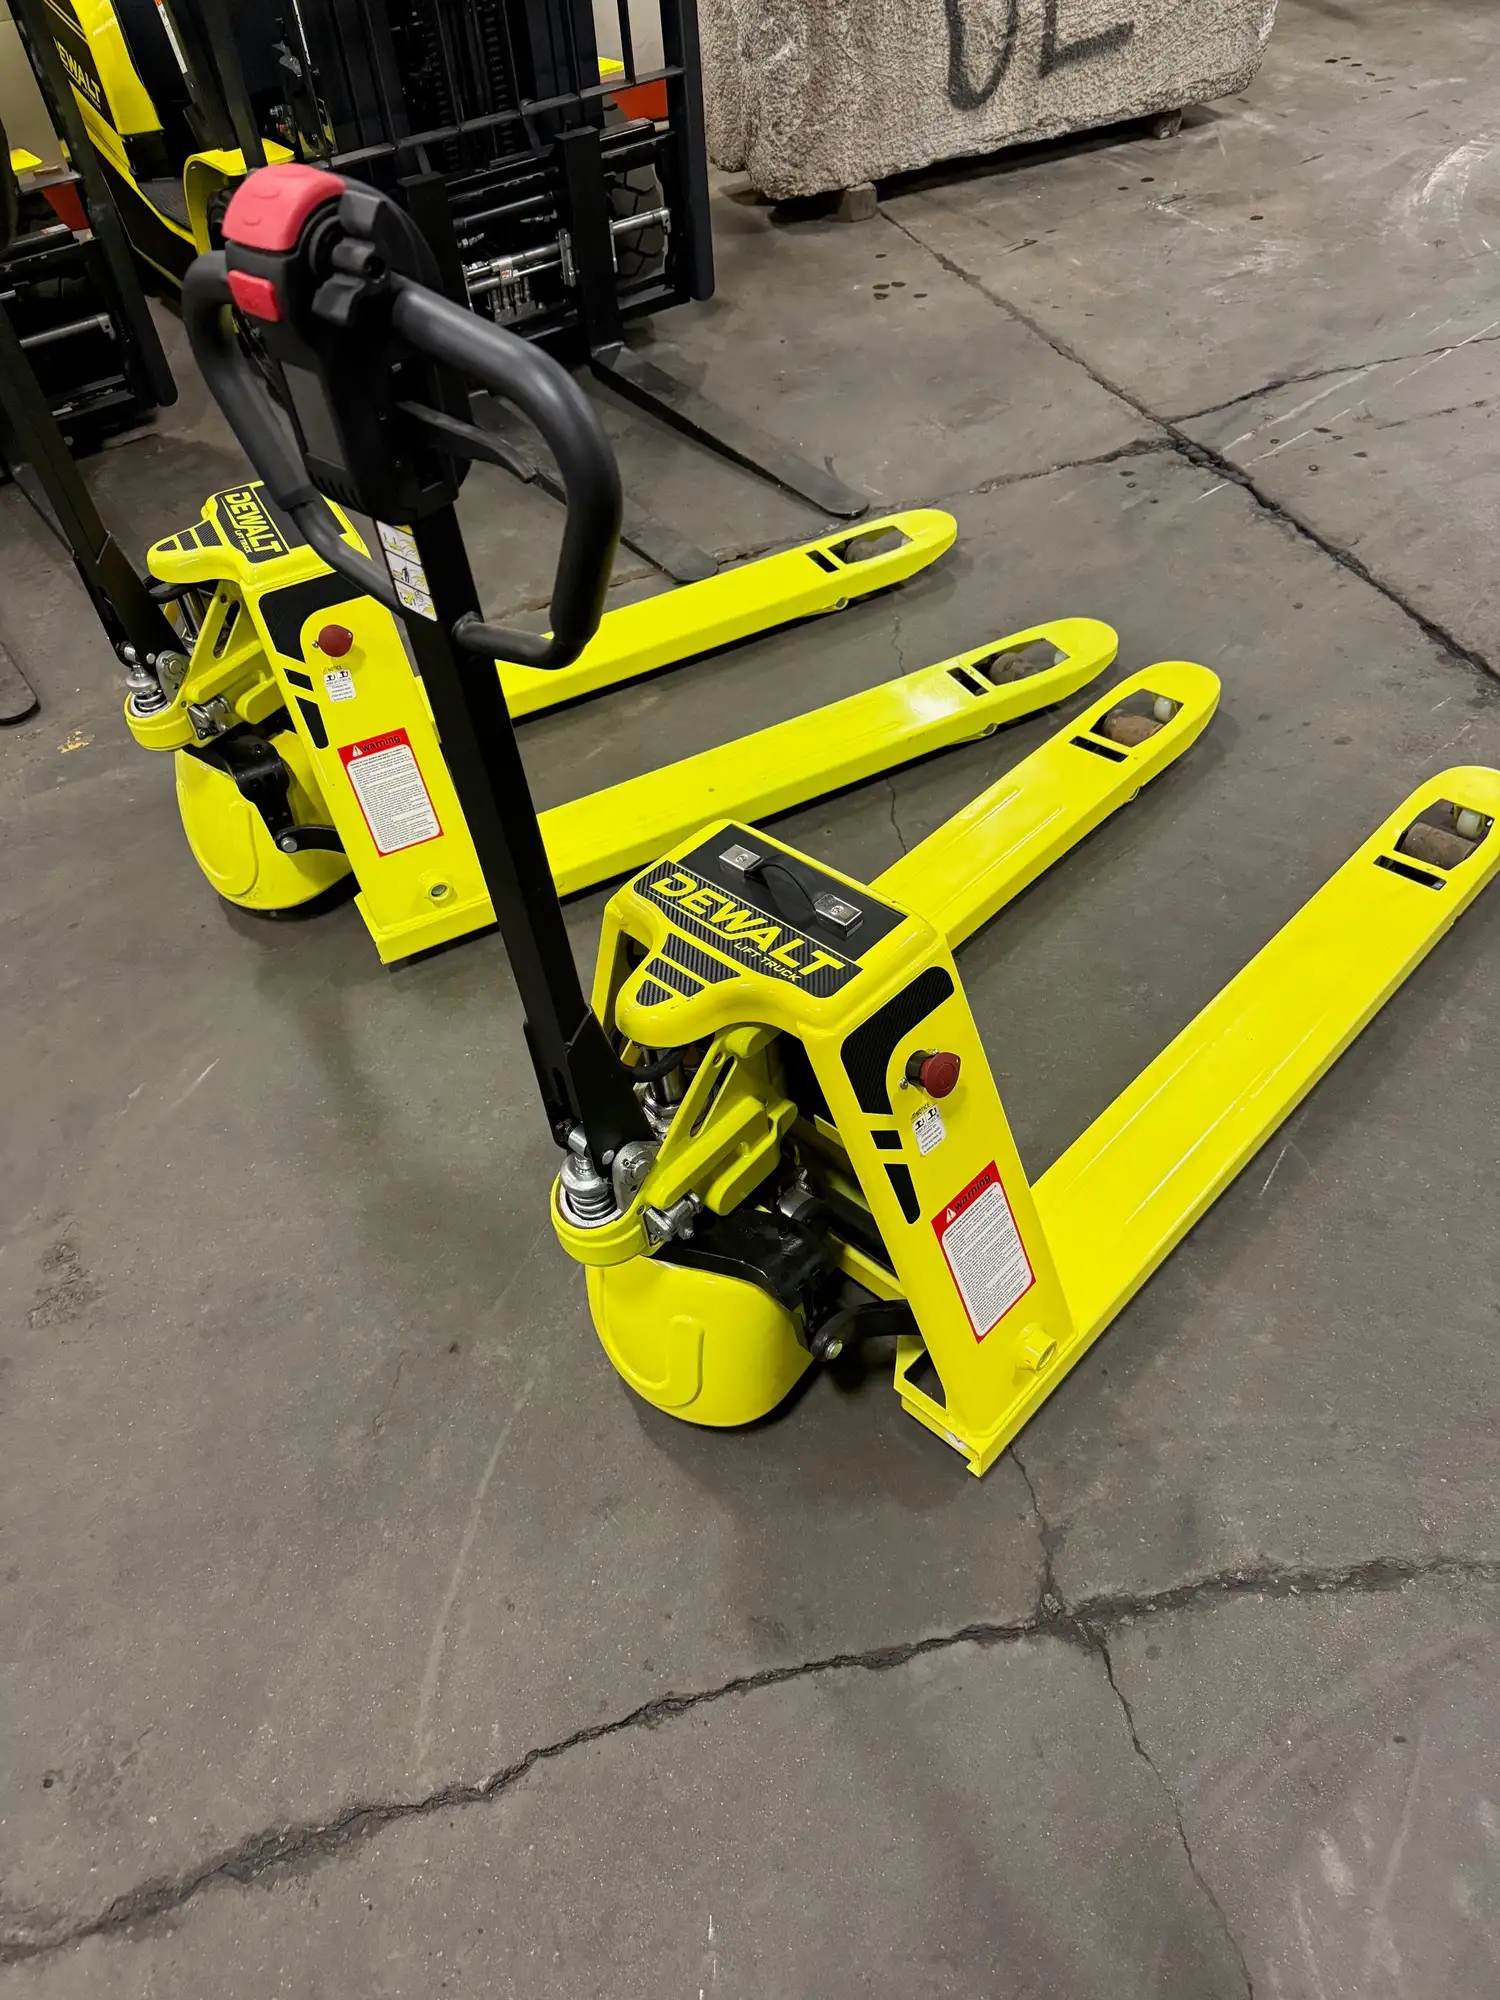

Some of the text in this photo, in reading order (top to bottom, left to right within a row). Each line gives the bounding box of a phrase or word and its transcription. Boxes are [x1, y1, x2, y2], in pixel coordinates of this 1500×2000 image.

[54, 39, 101, 104] EWALT
[225, 491, 284, 553] DEWALT
[361, 735, 401, 753] warning
[649, 871, 847, 976] DEWALT
[733, 941, 802, 983] LIFT TRUCK
[953, 1173, 992, 1212] warning
